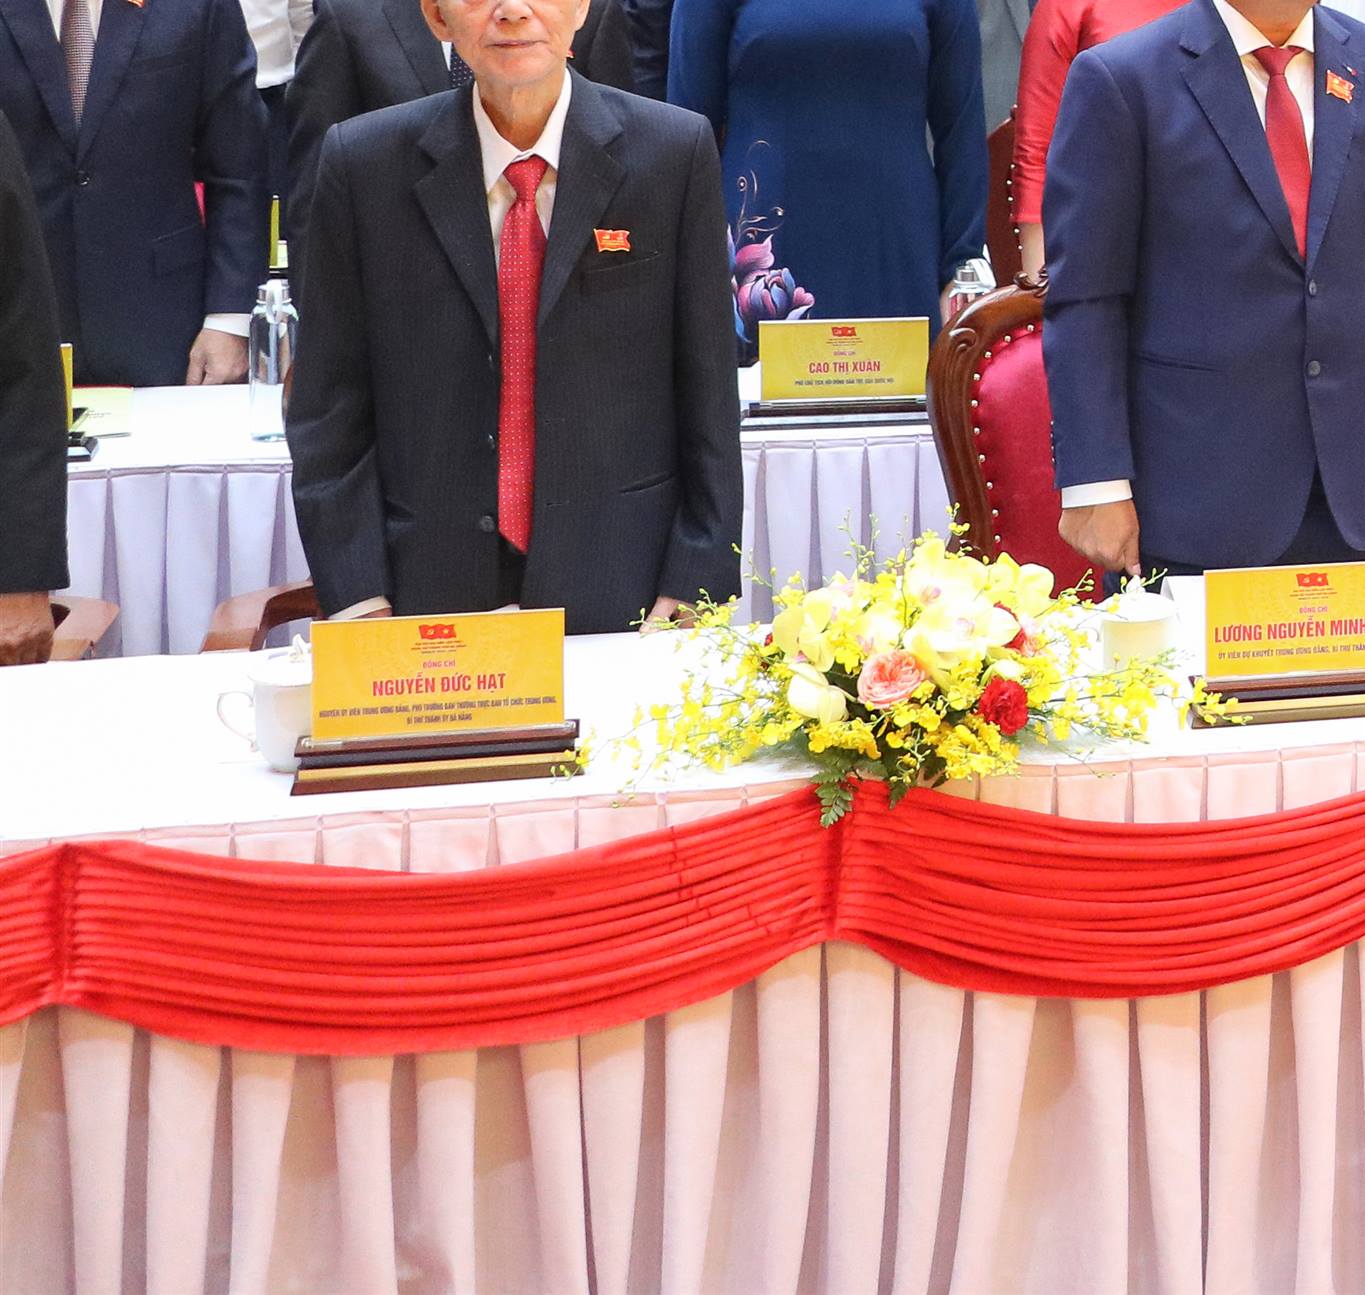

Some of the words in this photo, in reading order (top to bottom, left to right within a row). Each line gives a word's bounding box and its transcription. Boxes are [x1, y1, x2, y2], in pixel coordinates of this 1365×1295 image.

[808, 362, 830, 374] CAO
[832, 361, 849, 375] THỊ
[1214, 623, 1263, 643] LƯƠNG
[1267, 615, 1325, 640] NGUYỄN
[372, 672, 436, 697] NGUYỄN
[440, 671, 472, 692] ĐỨC
[477, 672, 507, 693] HẠT
